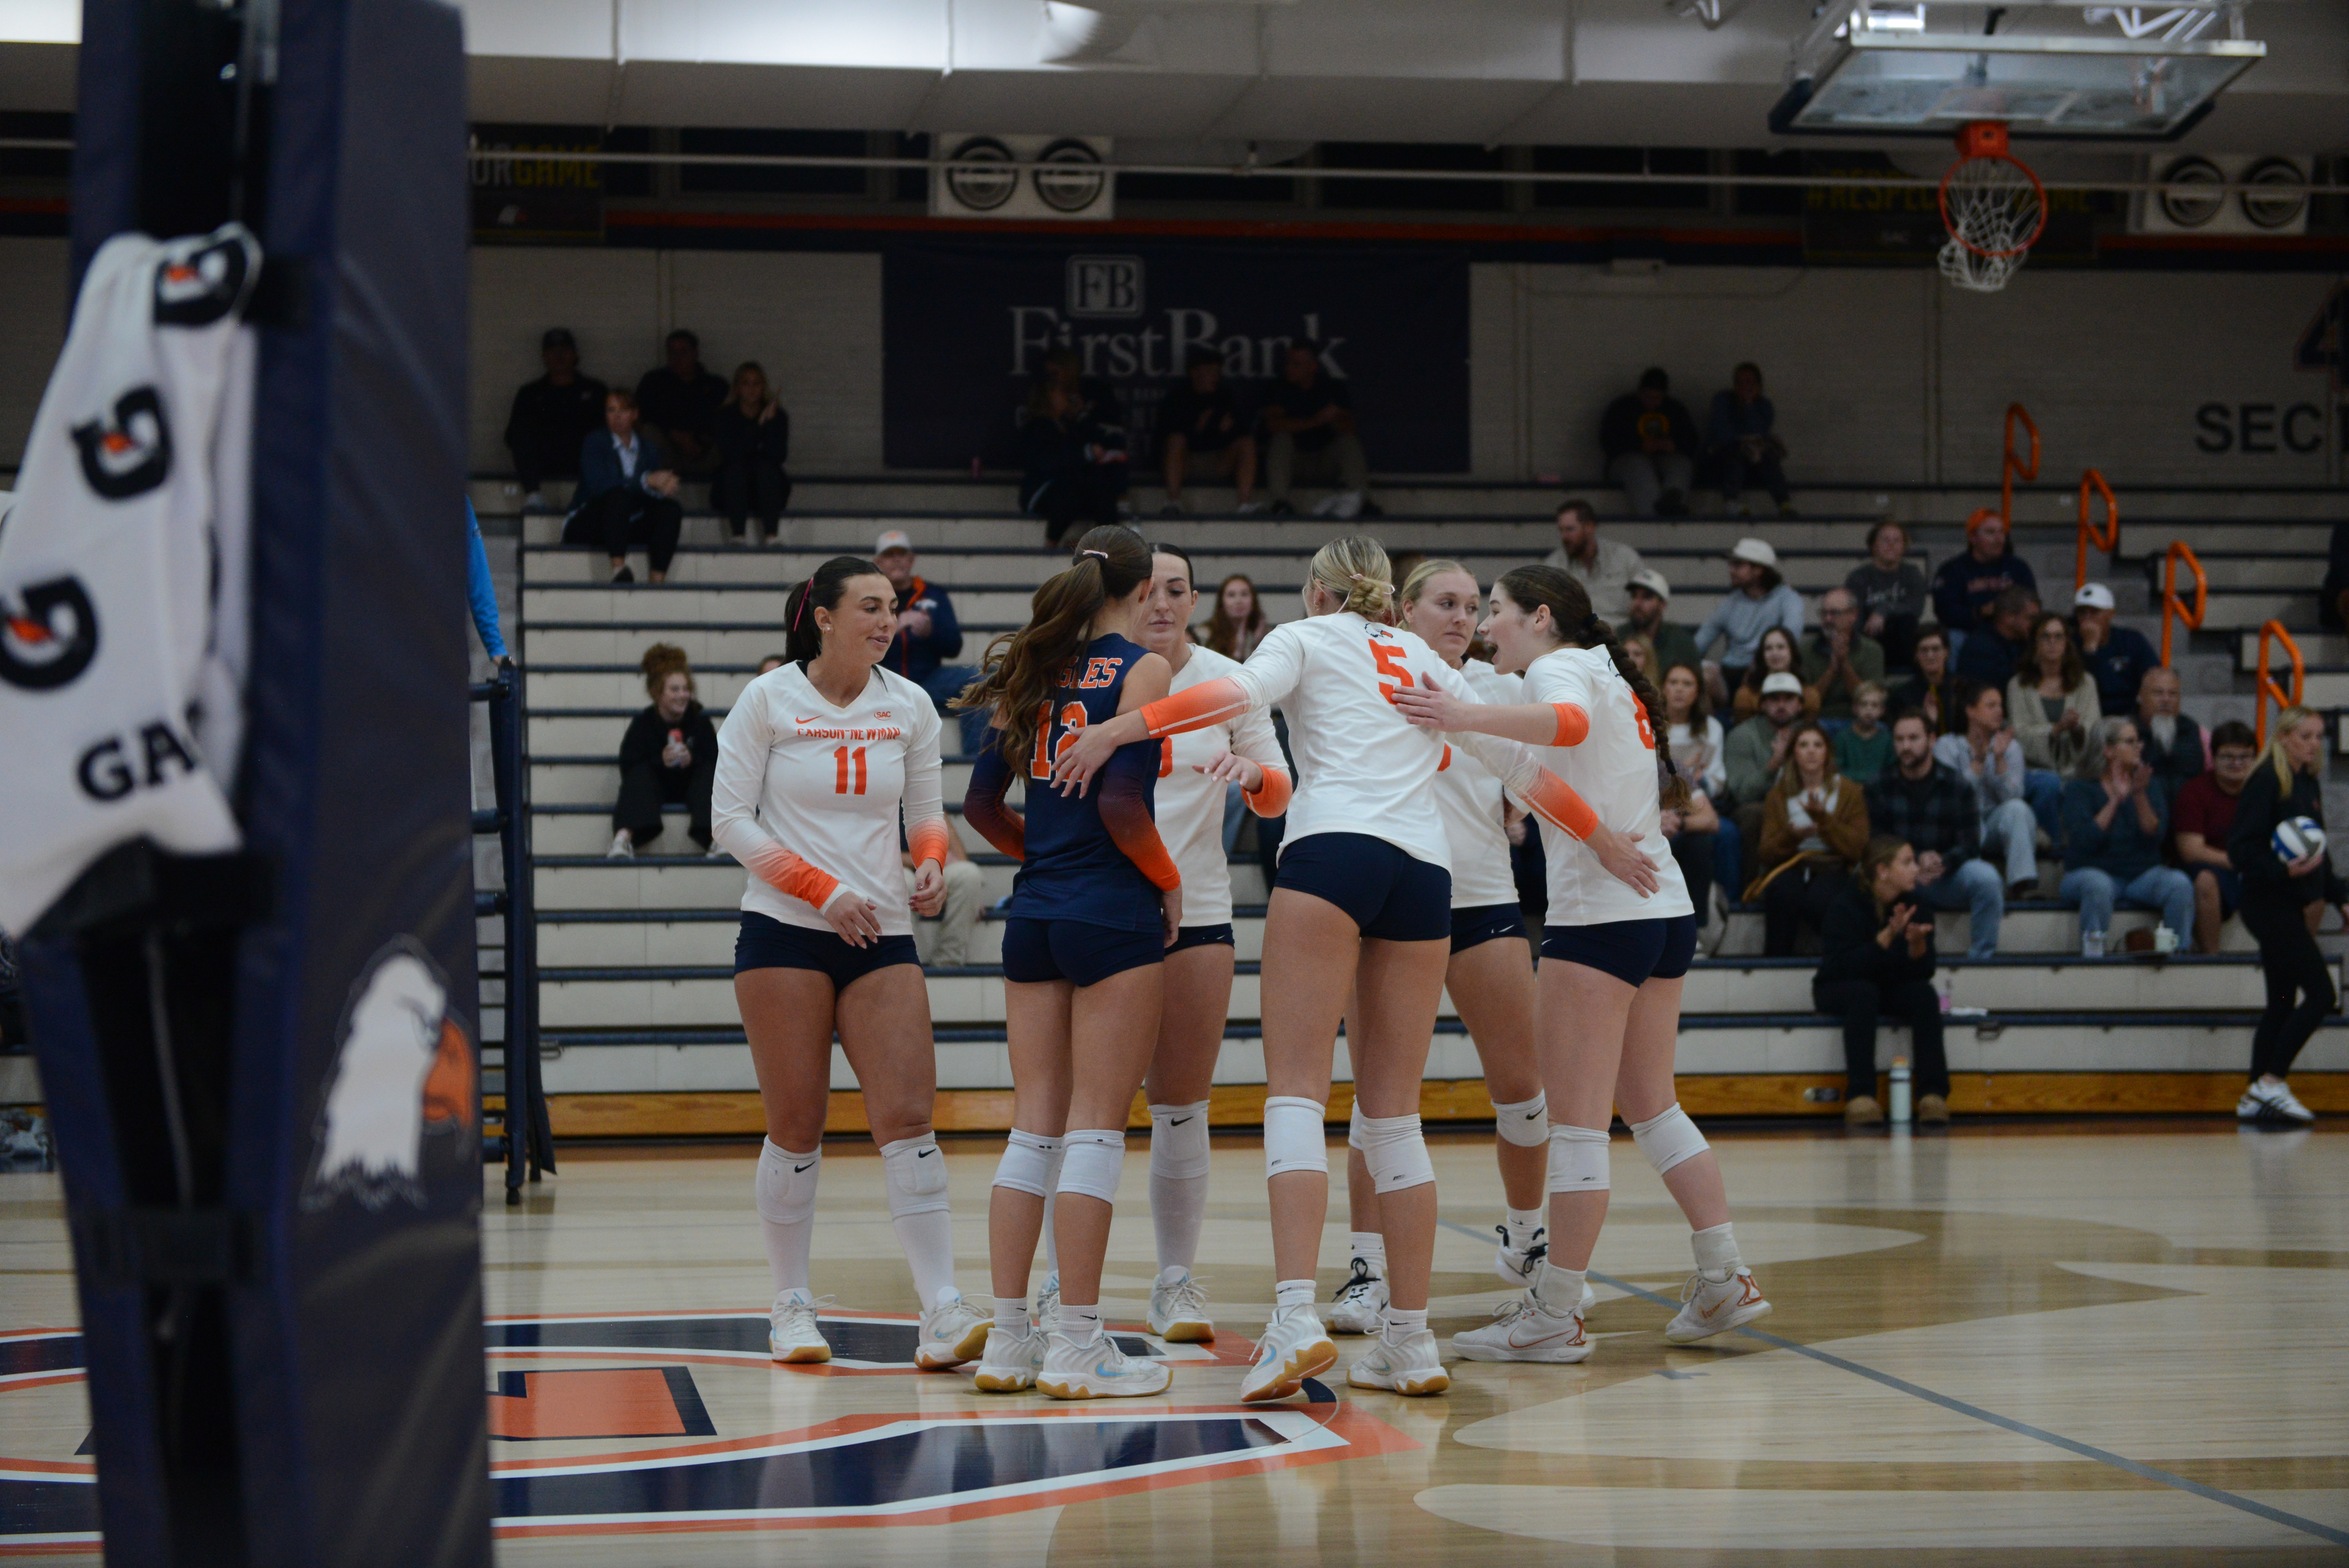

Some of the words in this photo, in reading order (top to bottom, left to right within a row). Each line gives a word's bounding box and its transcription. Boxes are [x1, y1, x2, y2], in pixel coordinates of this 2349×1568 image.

[1054, 656, 1123, 690] GLES
[1367, 638, 1416, 705] 5
[875, 710, 892, 719] SAC
[77, 702, 206, 801] GA
[833, 745, 867, 795] 11
